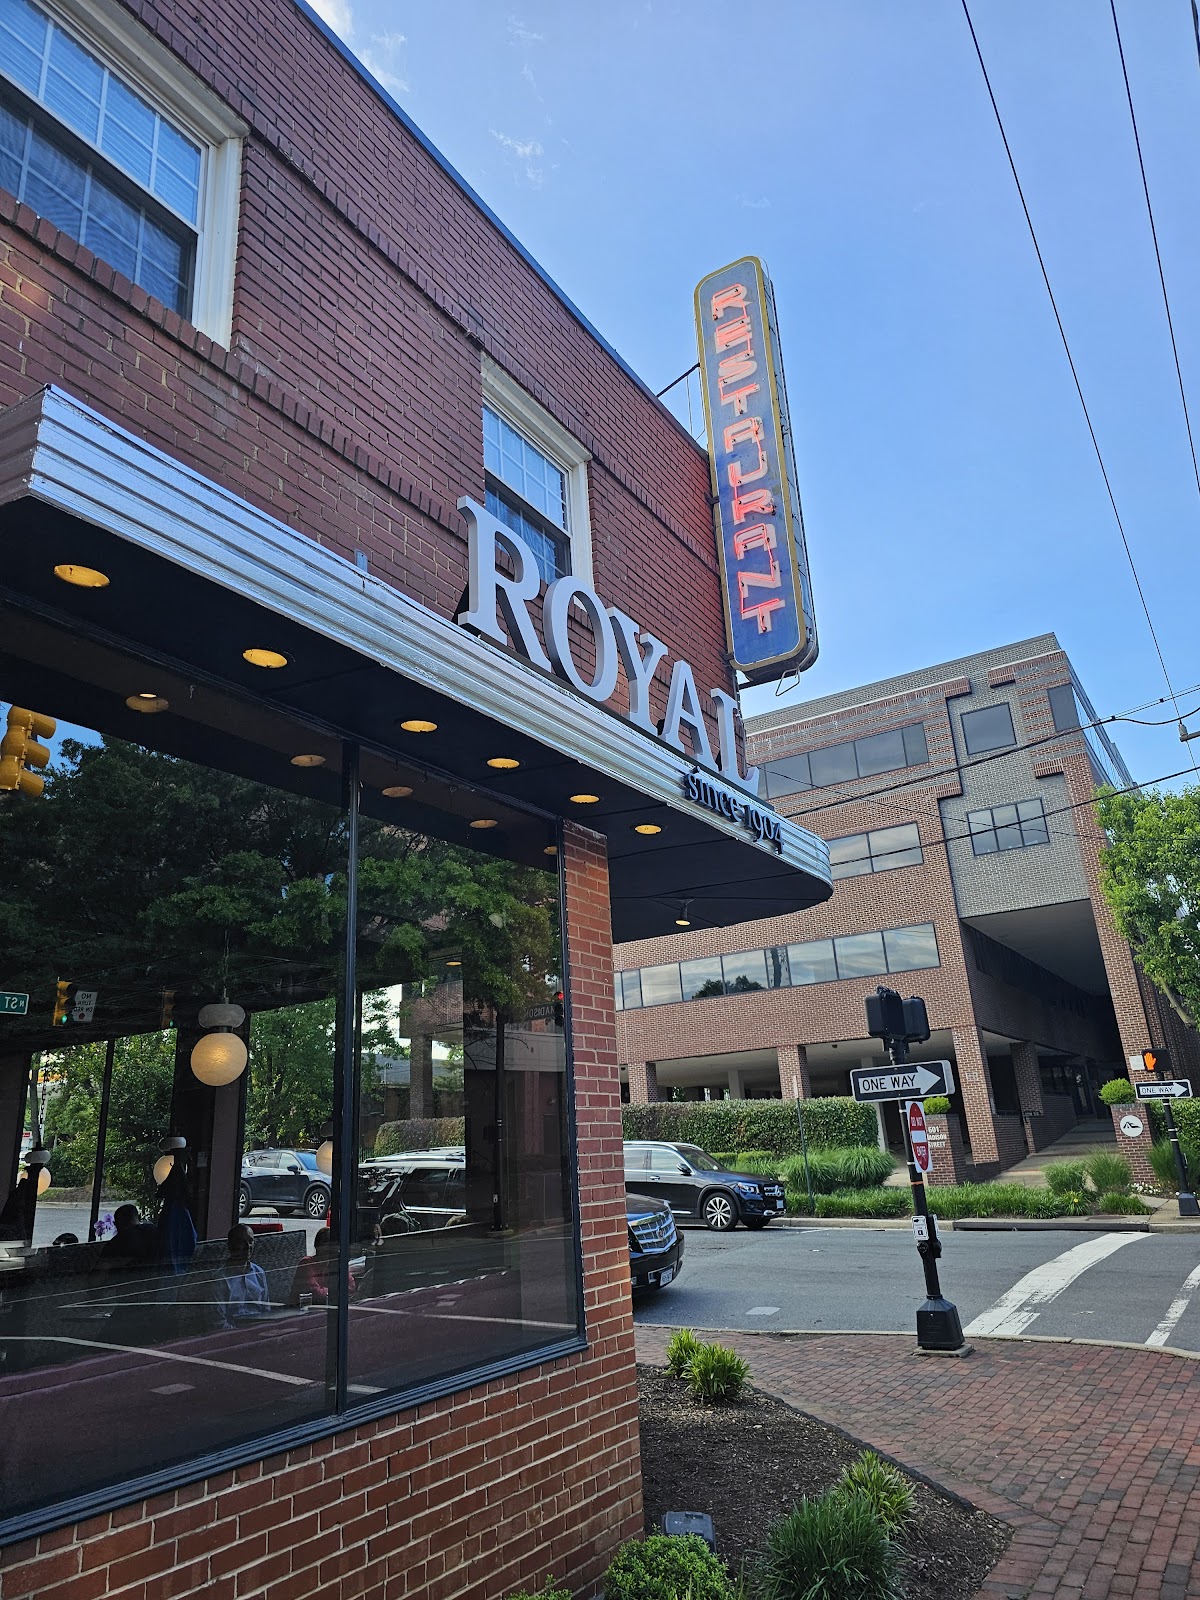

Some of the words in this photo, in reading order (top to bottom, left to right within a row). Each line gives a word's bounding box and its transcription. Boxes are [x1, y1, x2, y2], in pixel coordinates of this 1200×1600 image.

[711, 282, 786, 634] RESTAURANT
[456, 494, 760, 798] ROYAL
[742, 804, 784, 855] 1904
[862, 1077, 887, 1092] ONE
[890, 1074, 916, 1089] WAY
[911, 1117, 916, 1126] DO
[917, 1146, 926, 1156] ENTER
